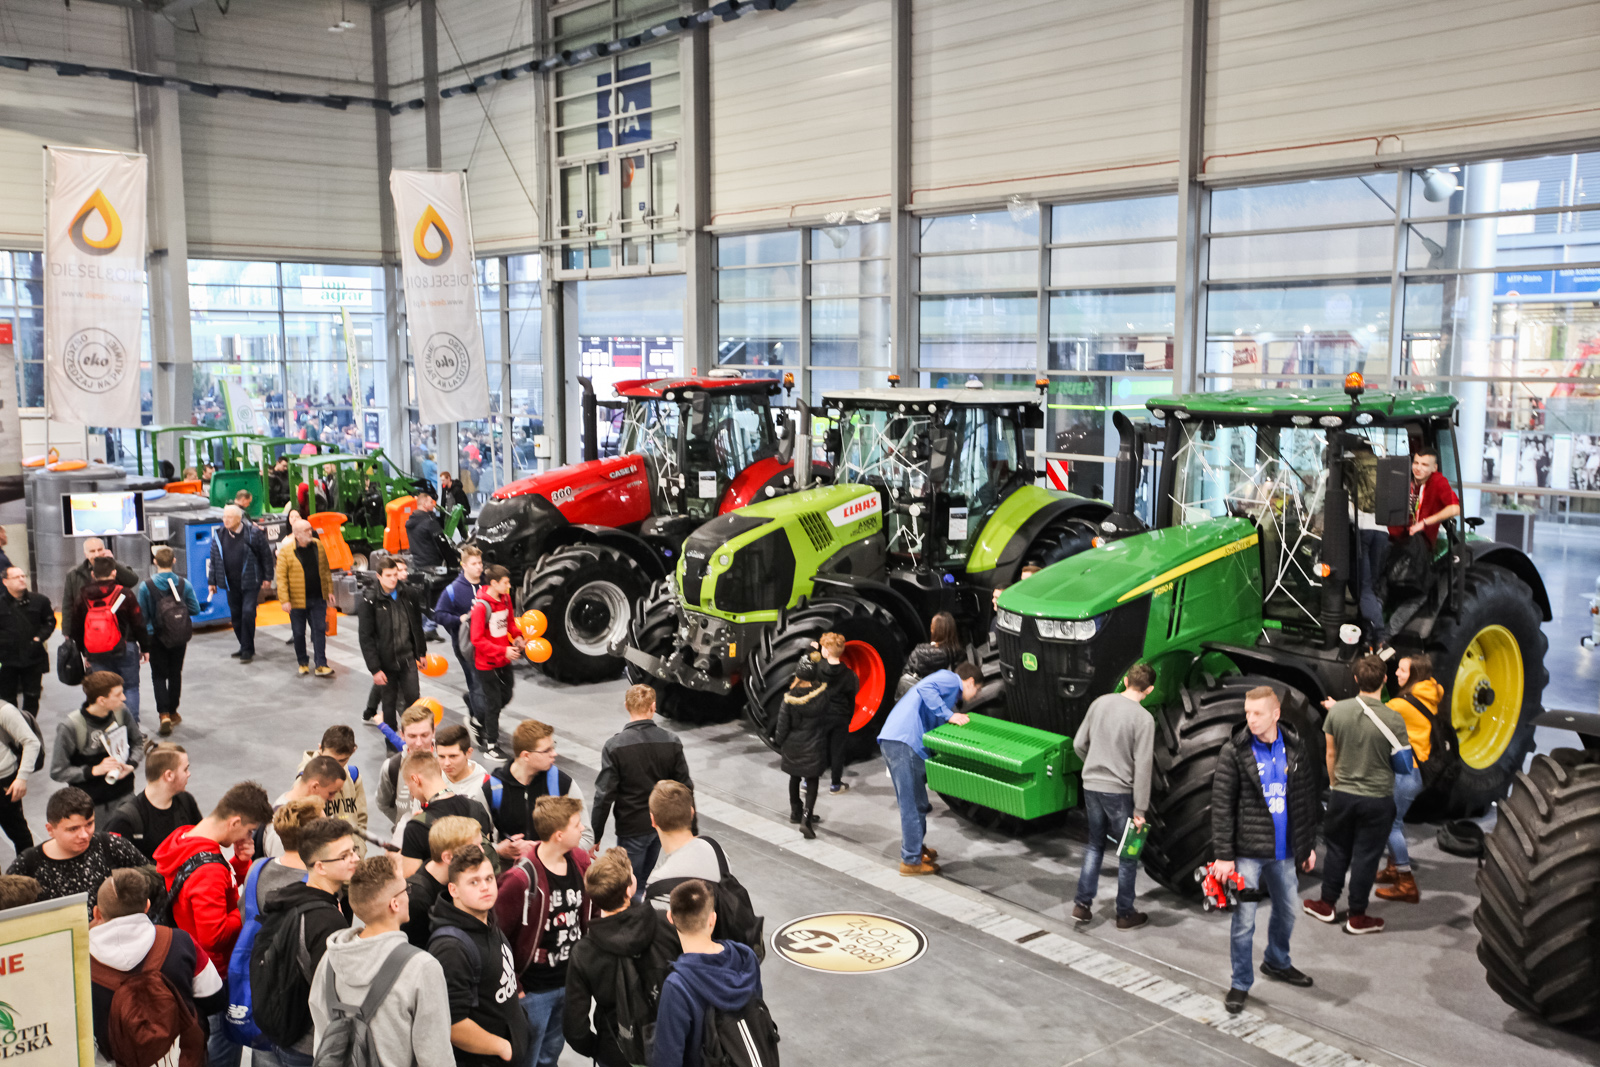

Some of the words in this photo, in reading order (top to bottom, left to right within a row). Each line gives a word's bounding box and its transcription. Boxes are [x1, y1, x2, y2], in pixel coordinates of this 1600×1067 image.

[608, 90, 640, 136] 8A
[51, 262, 142, 283] DIESEL&OIL
[321, 291, 364, 303] agrar
[83, 353, 109, 367] eko
[609, 467, 631, 479] CASE
[551, 486, 572, 502] 300
[843, 497, 877, 518] CLAAS
[837, 929, 902, 959] MEDAL
[839, 944, 885, 965] 2020
[2, 1022, 49, 1045] OTTI
